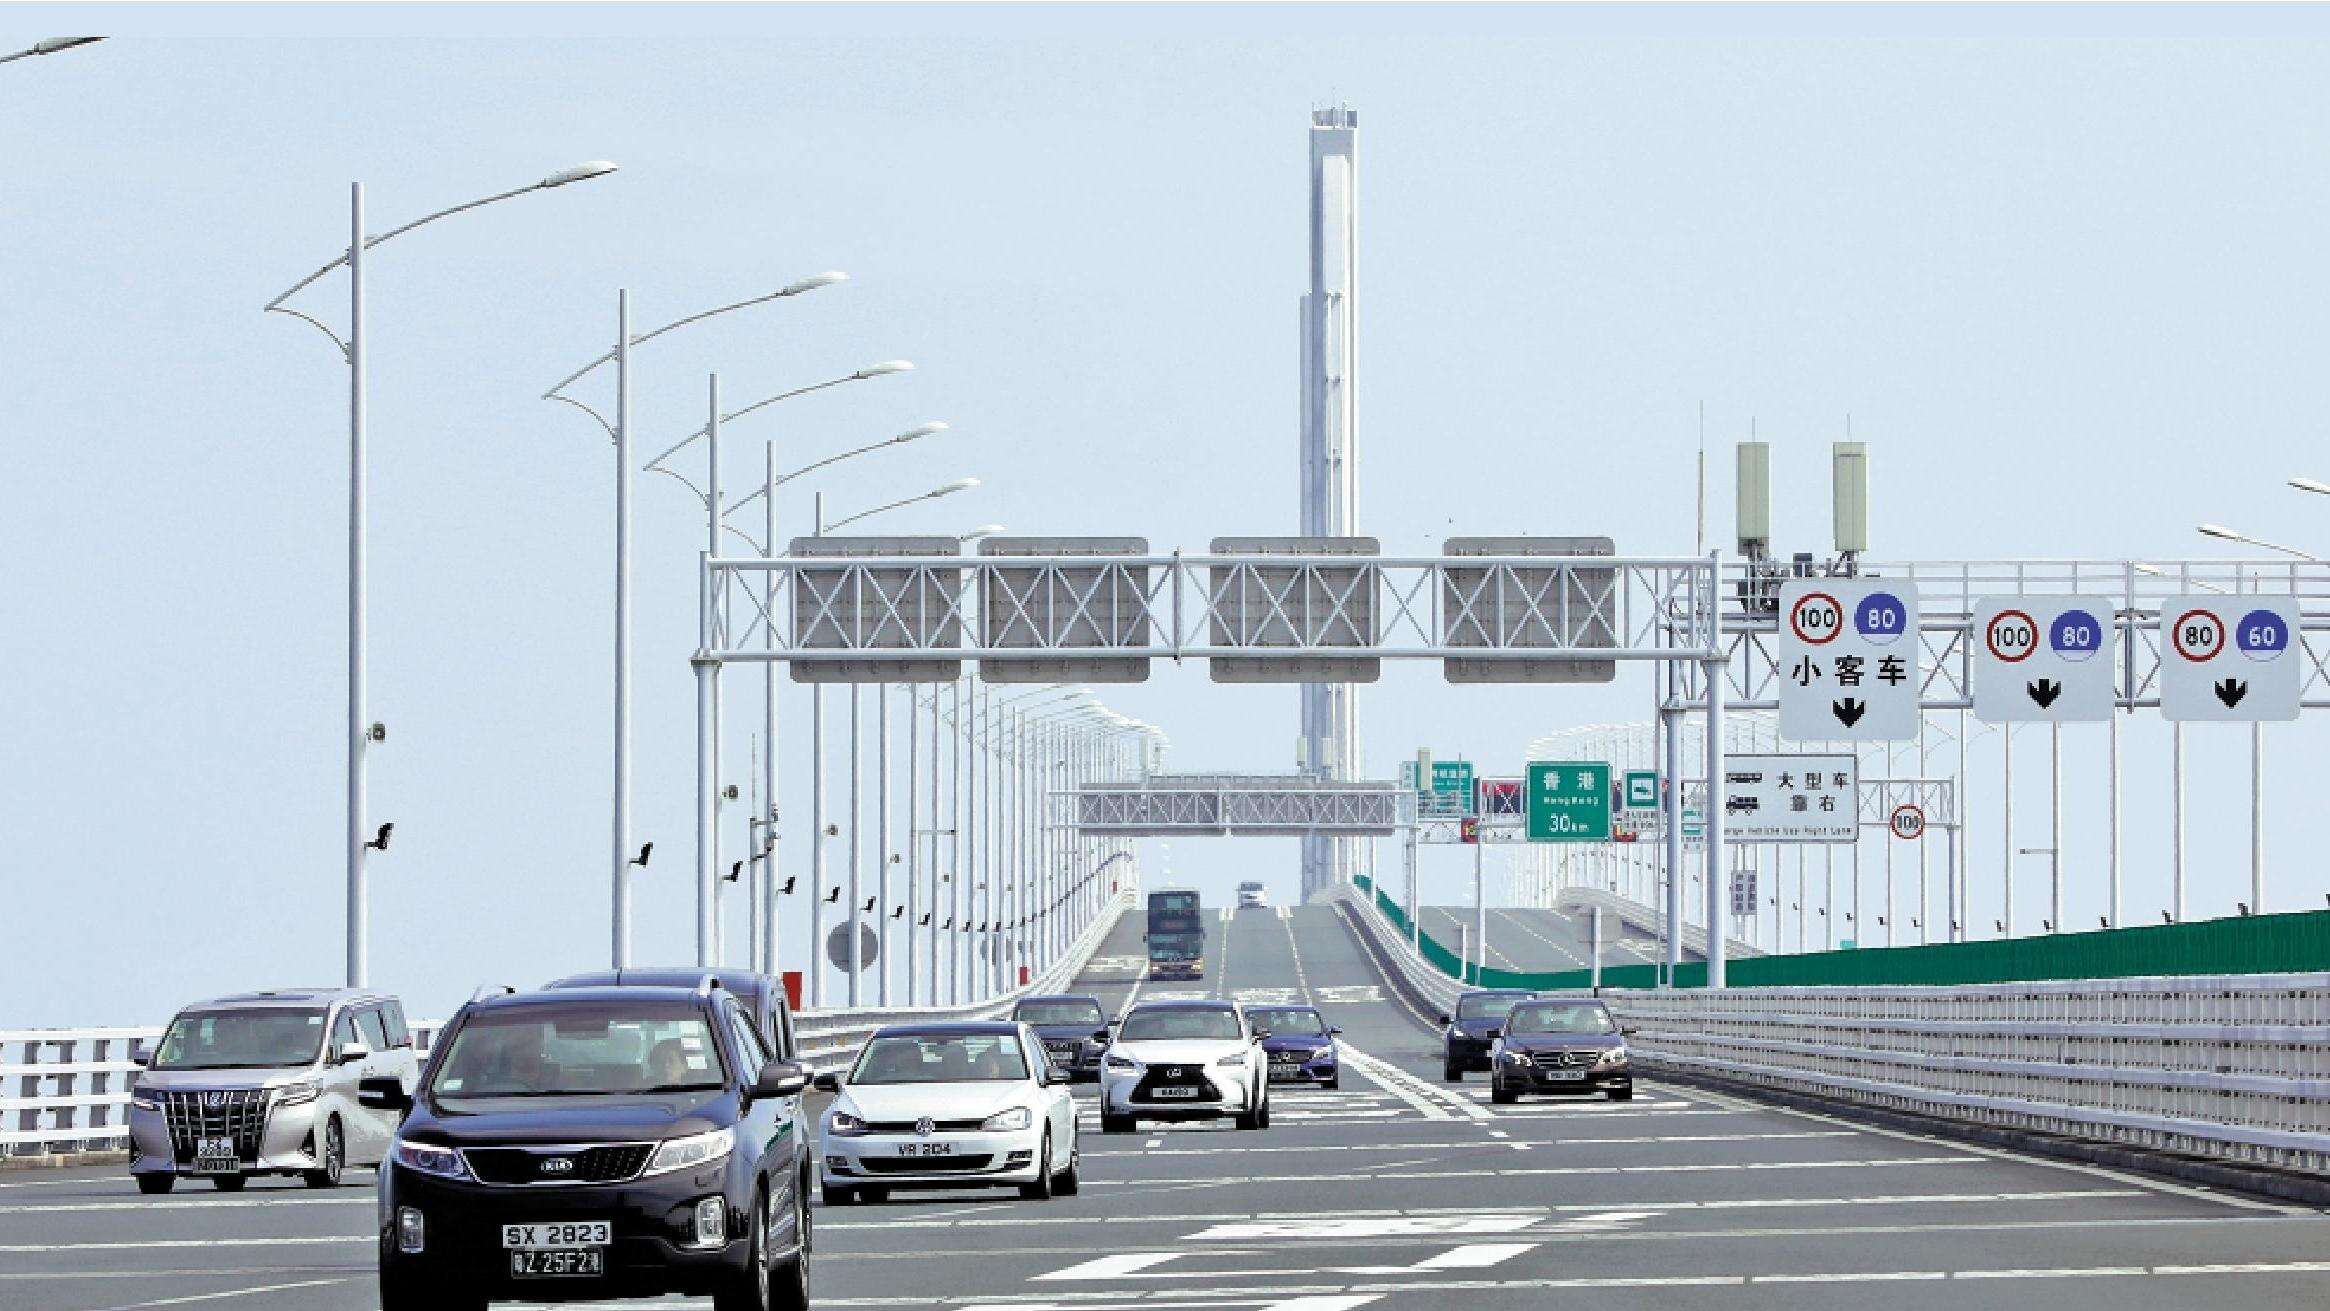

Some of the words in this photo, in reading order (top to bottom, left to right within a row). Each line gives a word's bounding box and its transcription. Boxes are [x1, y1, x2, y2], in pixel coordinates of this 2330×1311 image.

[1800, 607, 1836, 628] 100
[1868, 608, 1896, 629] 80
[1994, 626, 2031, 647] 100
[2062, 626, 2090, 647] 80
[2185, 626, 2213, 647] 80
[2249, 626, 2276, 647] 60
[1792, 655, 1906, 686] 小客车
[1777, 771, 1848, 790] 大型车
[1896, 815, 1919, 828] 100
[507, 1226, 535, 1245] SX
[548, 1224, 609, 1245] 2823
